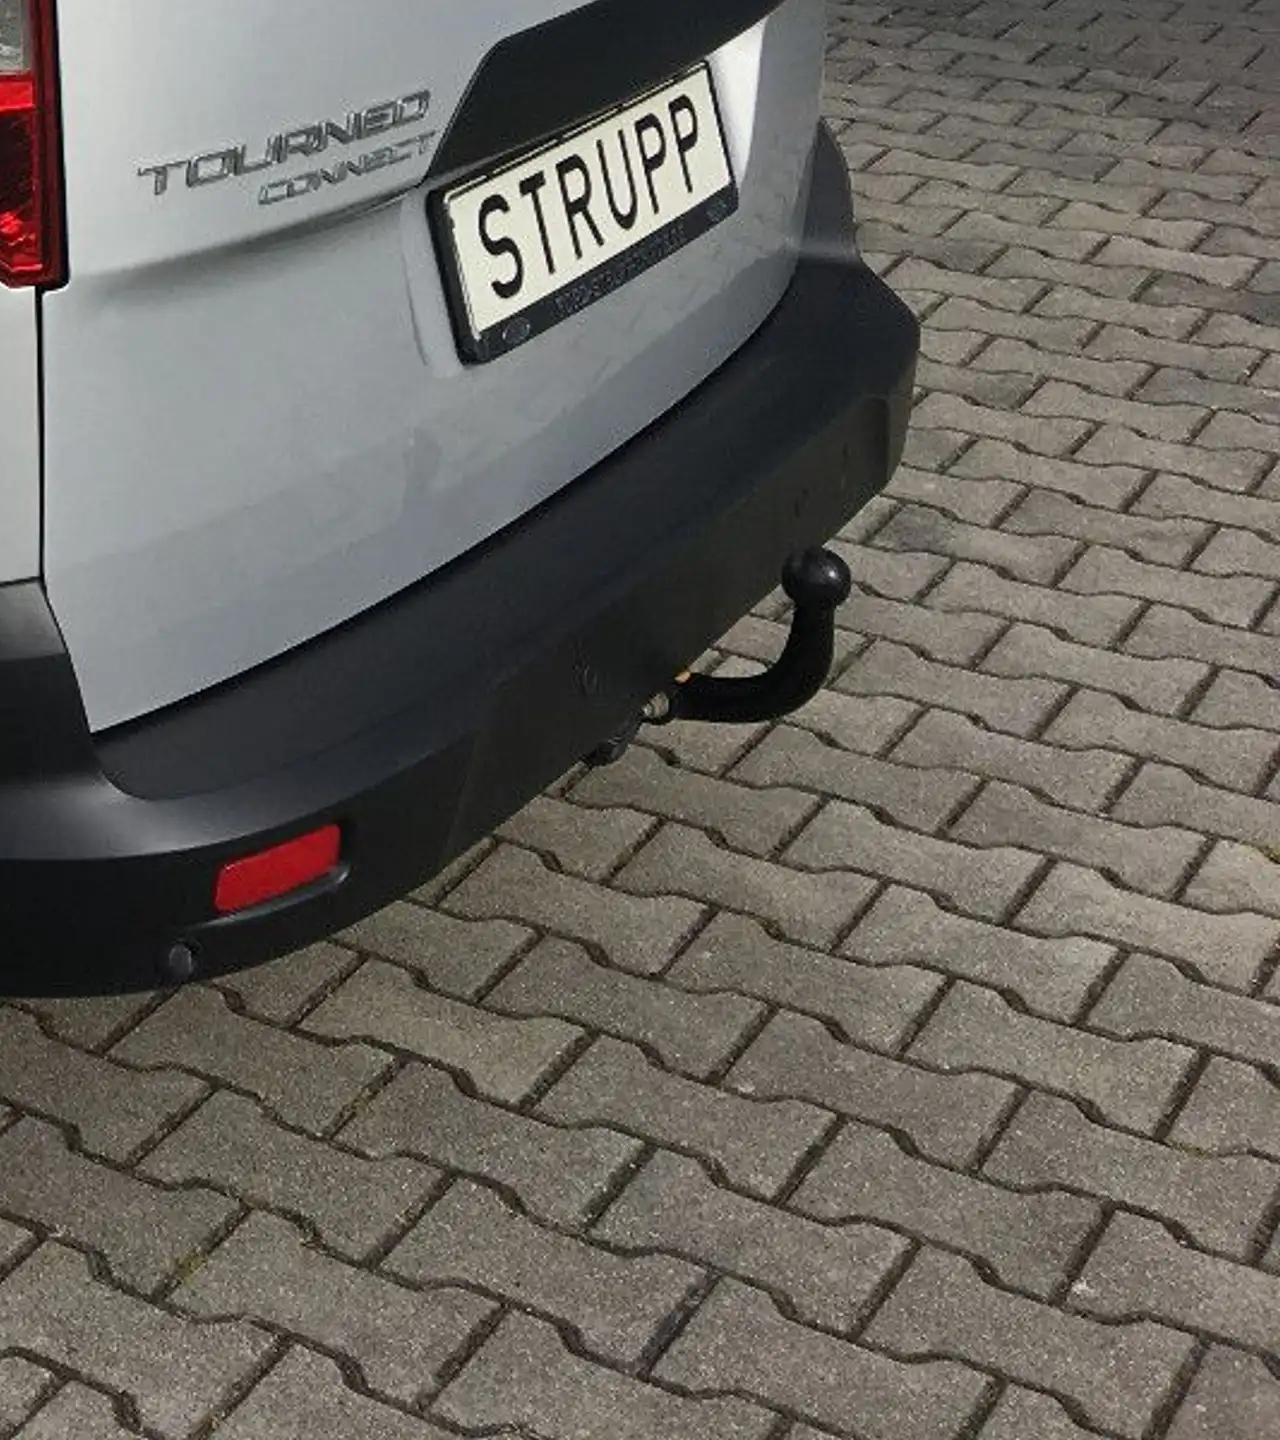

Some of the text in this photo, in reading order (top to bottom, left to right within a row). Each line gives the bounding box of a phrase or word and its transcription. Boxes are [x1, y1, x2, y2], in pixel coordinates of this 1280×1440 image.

[137, 89, 431, 195] TOURNEO
[258, 130, 436, 205] CONNECT
[478, 94, 698, 299] STRUPP
